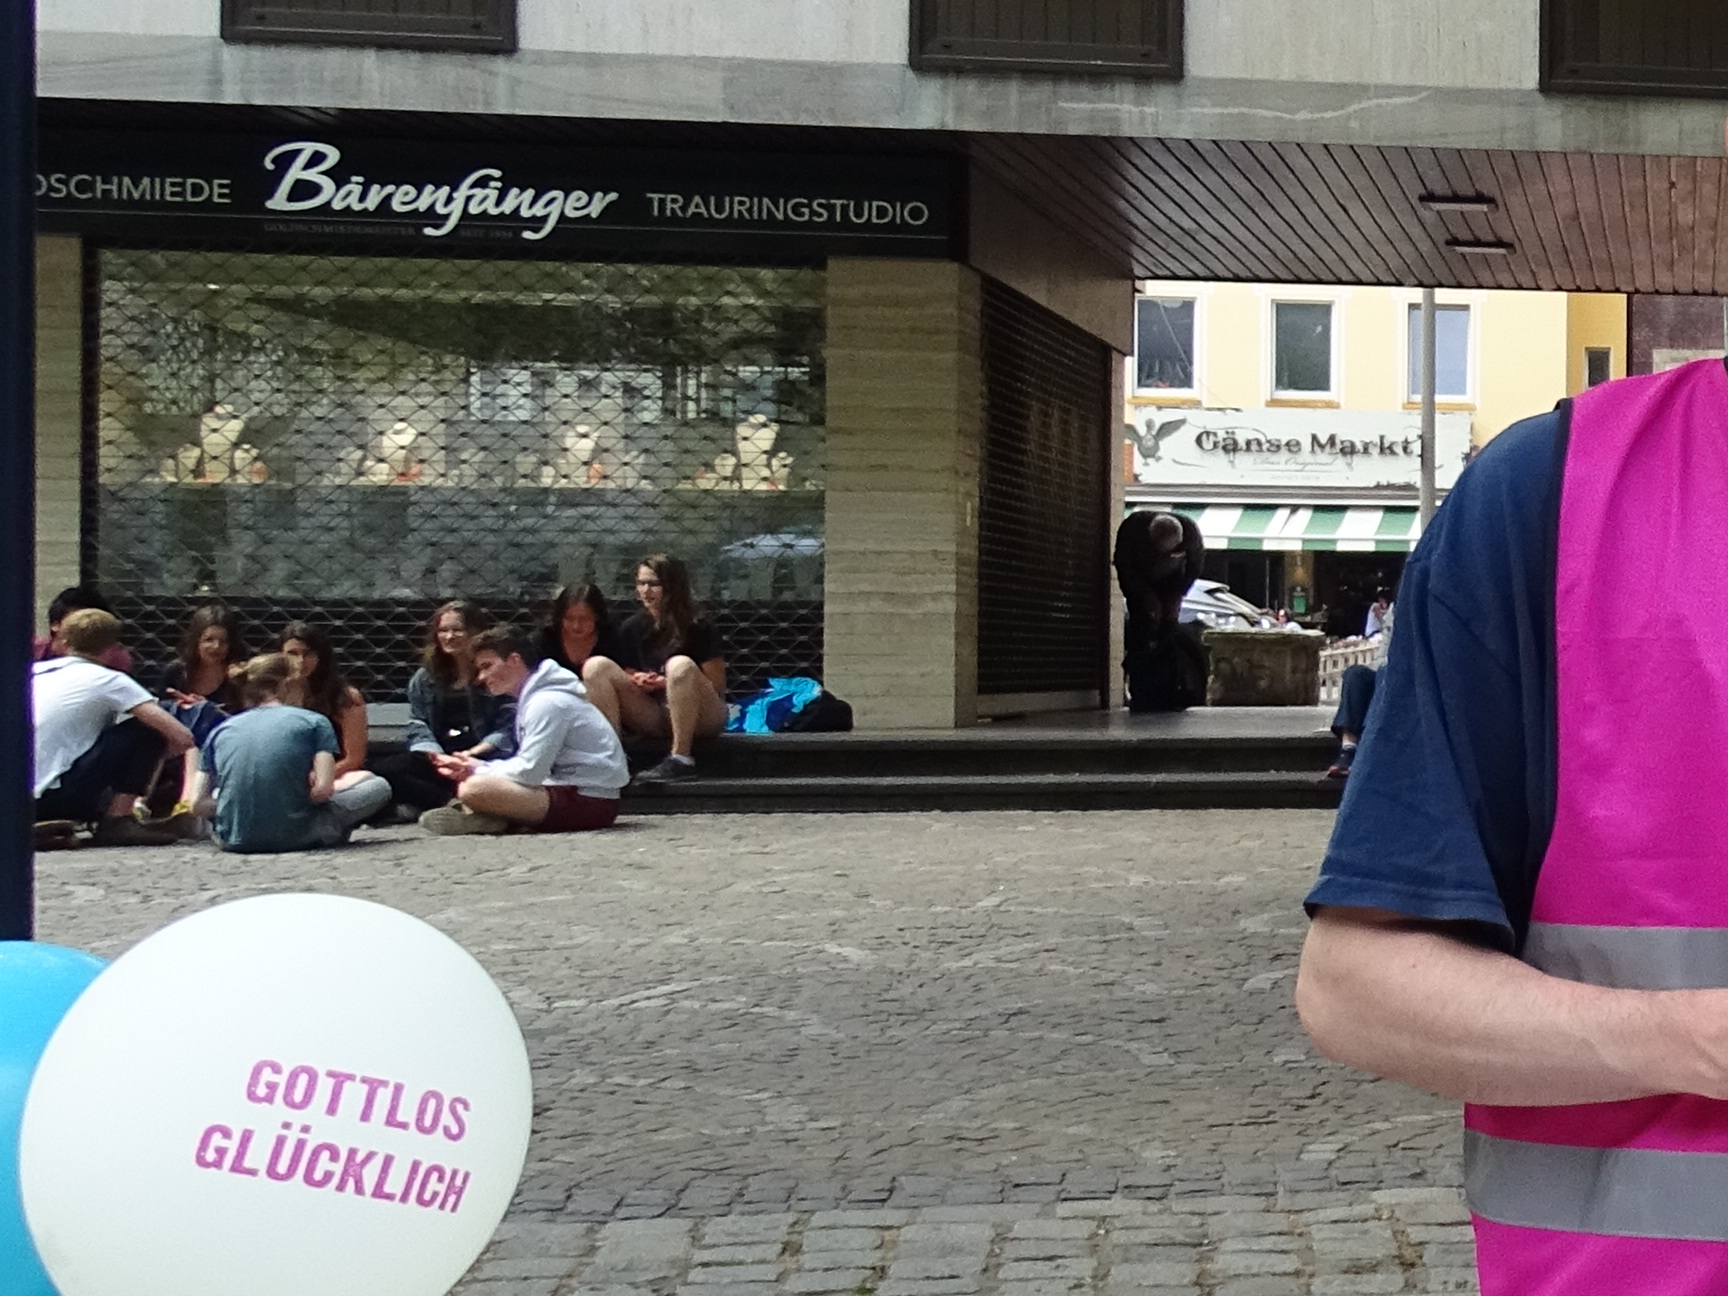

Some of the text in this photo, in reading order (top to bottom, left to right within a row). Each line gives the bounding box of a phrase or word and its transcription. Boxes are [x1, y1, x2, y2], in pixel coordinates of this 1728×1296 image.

[263, 141, 620, 240] Bärenfänger
[646, 193, 929, 225] TRAURINGSTUDIO
[1195, 430, 1415, 456] Gänse Markt
[246, 1059, 471, 1142] GOTTLOS
[196, 1121, 471, 1214] GLÜCKLICH
